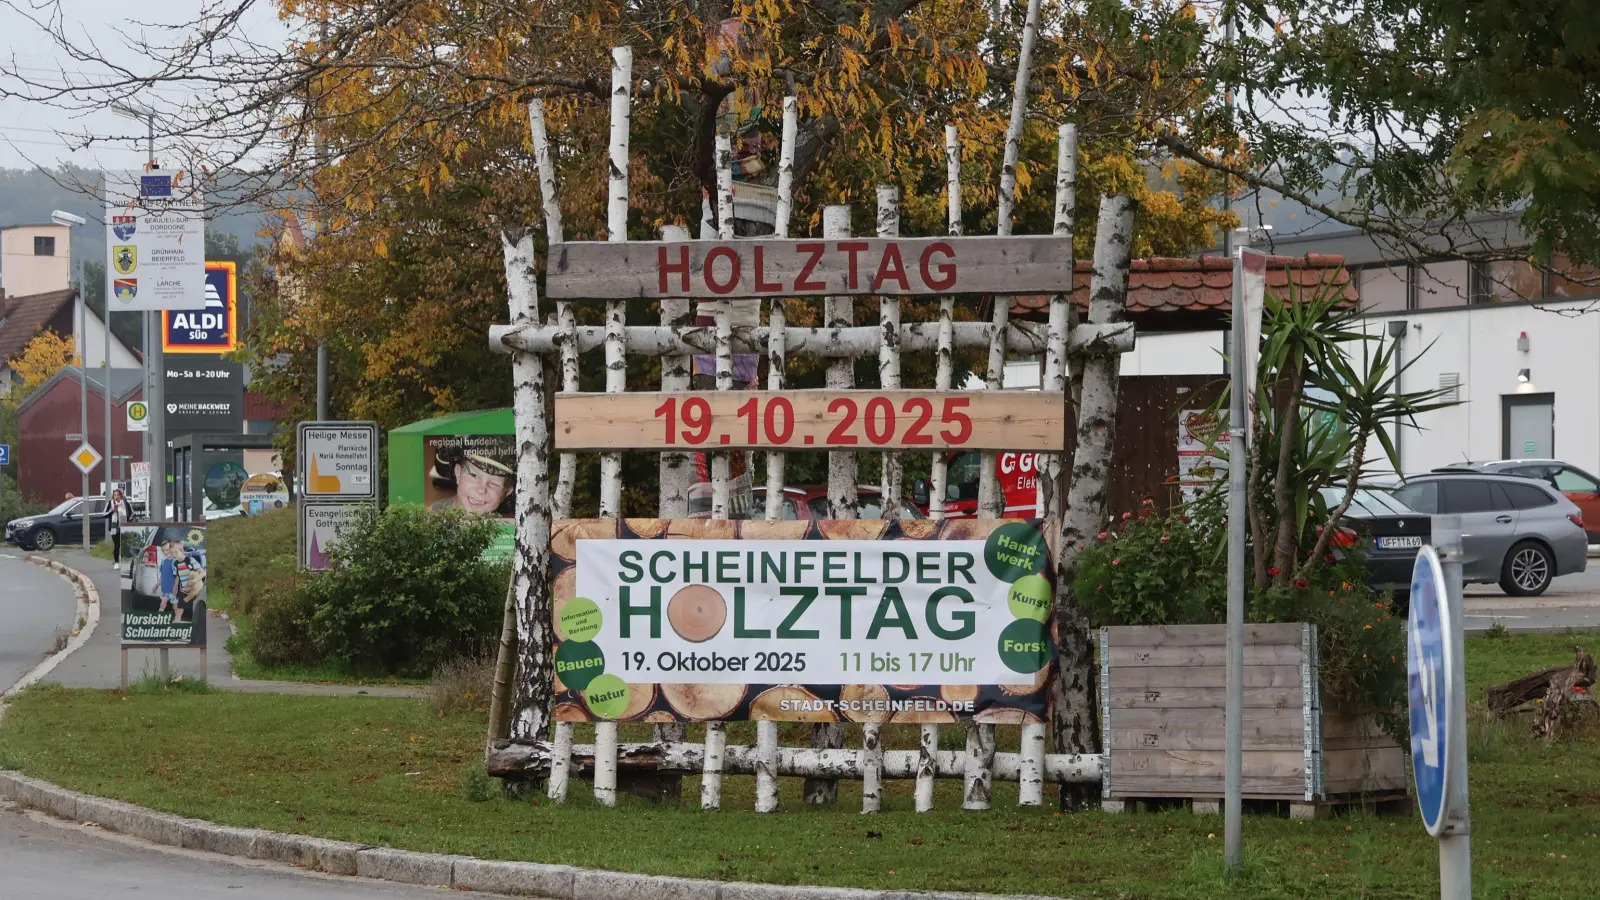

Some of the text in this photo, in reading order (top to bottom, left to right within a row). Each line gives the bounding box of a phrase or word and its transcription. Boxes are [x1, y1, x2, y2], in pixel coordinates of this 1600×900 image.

[657, 242, 957, 294] HOLZTAG
[173, 313, 223, 330] ALDI
[189, 330, 208, 340] SÜD
[216, 370, 230, 378] Uhr
[654, 396, 973, 446] 19.10.2025
[308, 431, 368, 441] Heilige Messe
[429, 437, 497, 448] regional handeln
[463, 447, 497, 458] regional
[335, 462, 368, 473] Sonntag
[997, 534, 1041, 557] Hand-
[1382, 537, 1397, 547] UFF
[618, 550, 976, 584] SCHEINFELDER
[996, 550, 1034, 571] werk
[1012, 591, 1050, 610] Kunst
[126, 613, 172, 625] Vorsicht!
[561, 607, 599, 622] Information
[568, 622, 598, 635] Beratung
[575, 618, 588, 626] und
[125, 626, 193, 639] Schulanfang!
[1003, 640, 1046, 653] Forst
[556, 656, 603, 673] Bauen
[622, 651, 806, 672] 19. Oktober 2025
[840, 652, 976, 673] 11 bis 17 Uhr
[589, 688, 626, 705] Natur
[780, 699, 975, 712] STADT-SCHEINFELD.DE
